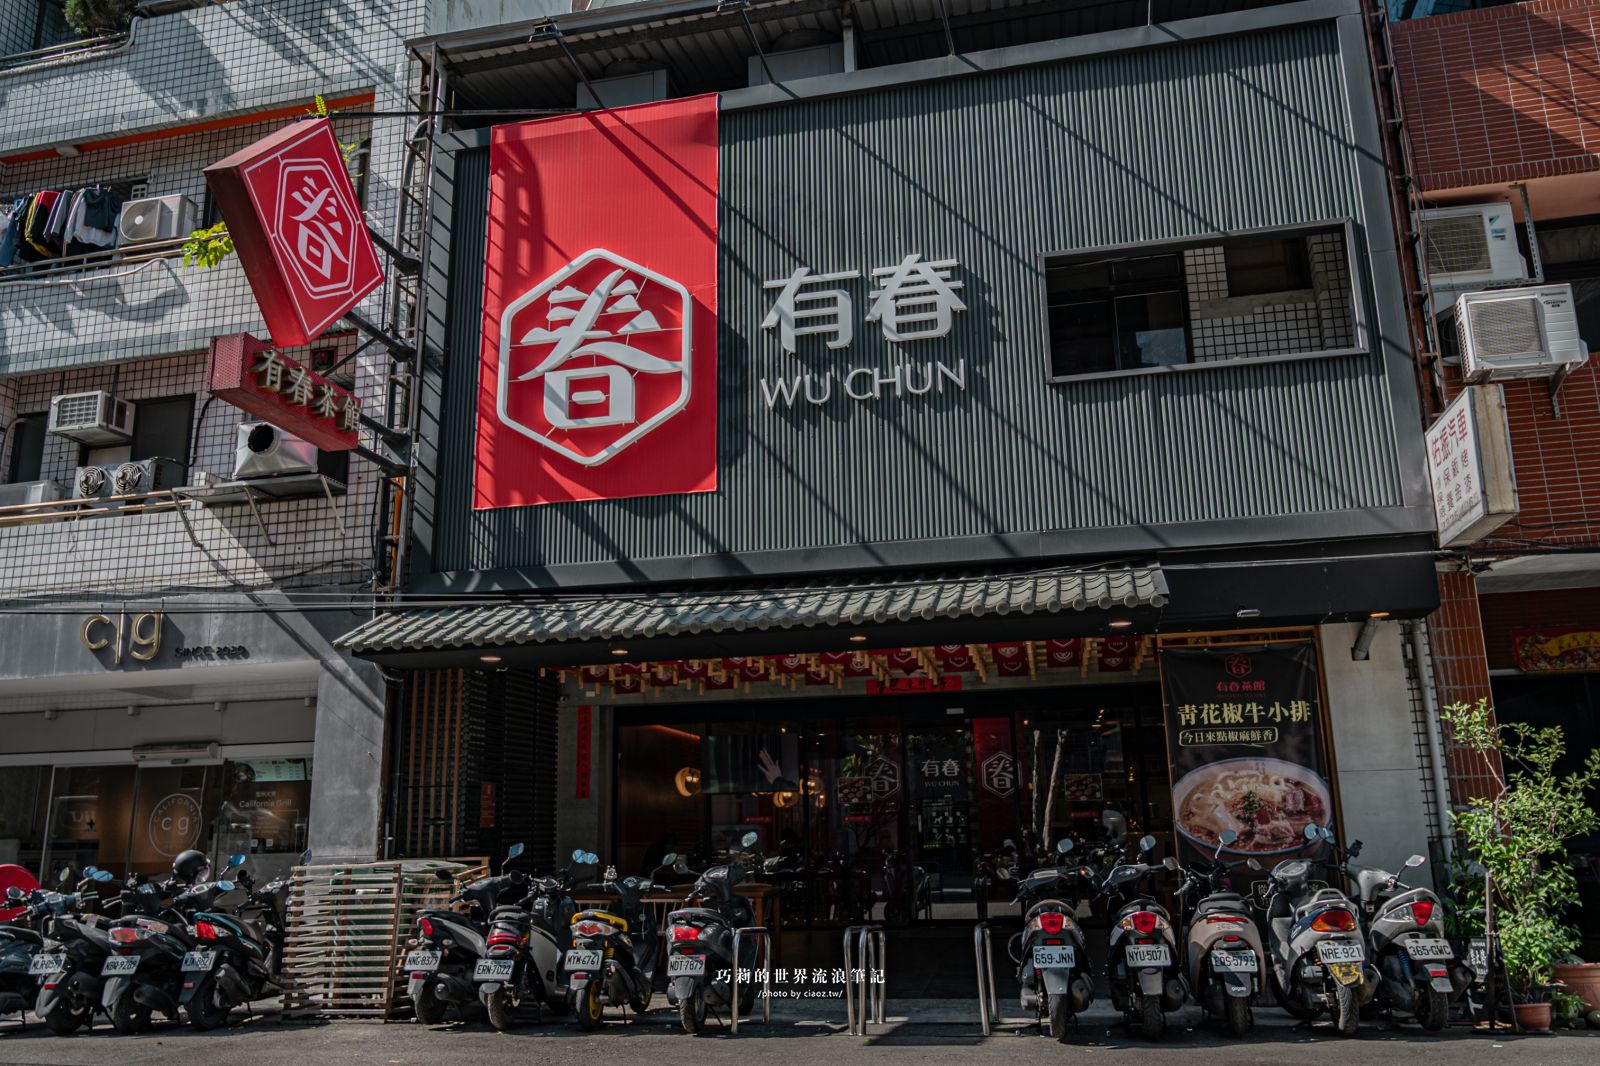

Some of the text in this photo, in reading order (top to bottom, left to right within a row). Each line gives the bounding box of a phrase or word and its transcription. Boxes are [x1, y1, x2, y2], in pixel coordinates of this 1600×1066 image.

[761, 253, 968, 355] 有春
[517, 268, 684, 430] 春
[251, 349, 362, 432] 有春茶館
[760, 358, 967, 410] WU CHUN
[1177, 701, 1312, 726] 青花椒牛小排
[1183, 729, 1274, 744] 今日來點椒麻鮮香
[921, 758, 960, 777] 有春
[239, 799, 275, 808] California
[1127, 950, 1168, 962] NYU-5071
[1320, 947, 1361, 960] NRE-921
[1408, 945, 1452, 957] 365-GWC
[668, 960, 704, 971] NDT-7879
[1034, 952, 1074, 965] 659-JNN
[476, 964, 512, 976] ERN-7022
